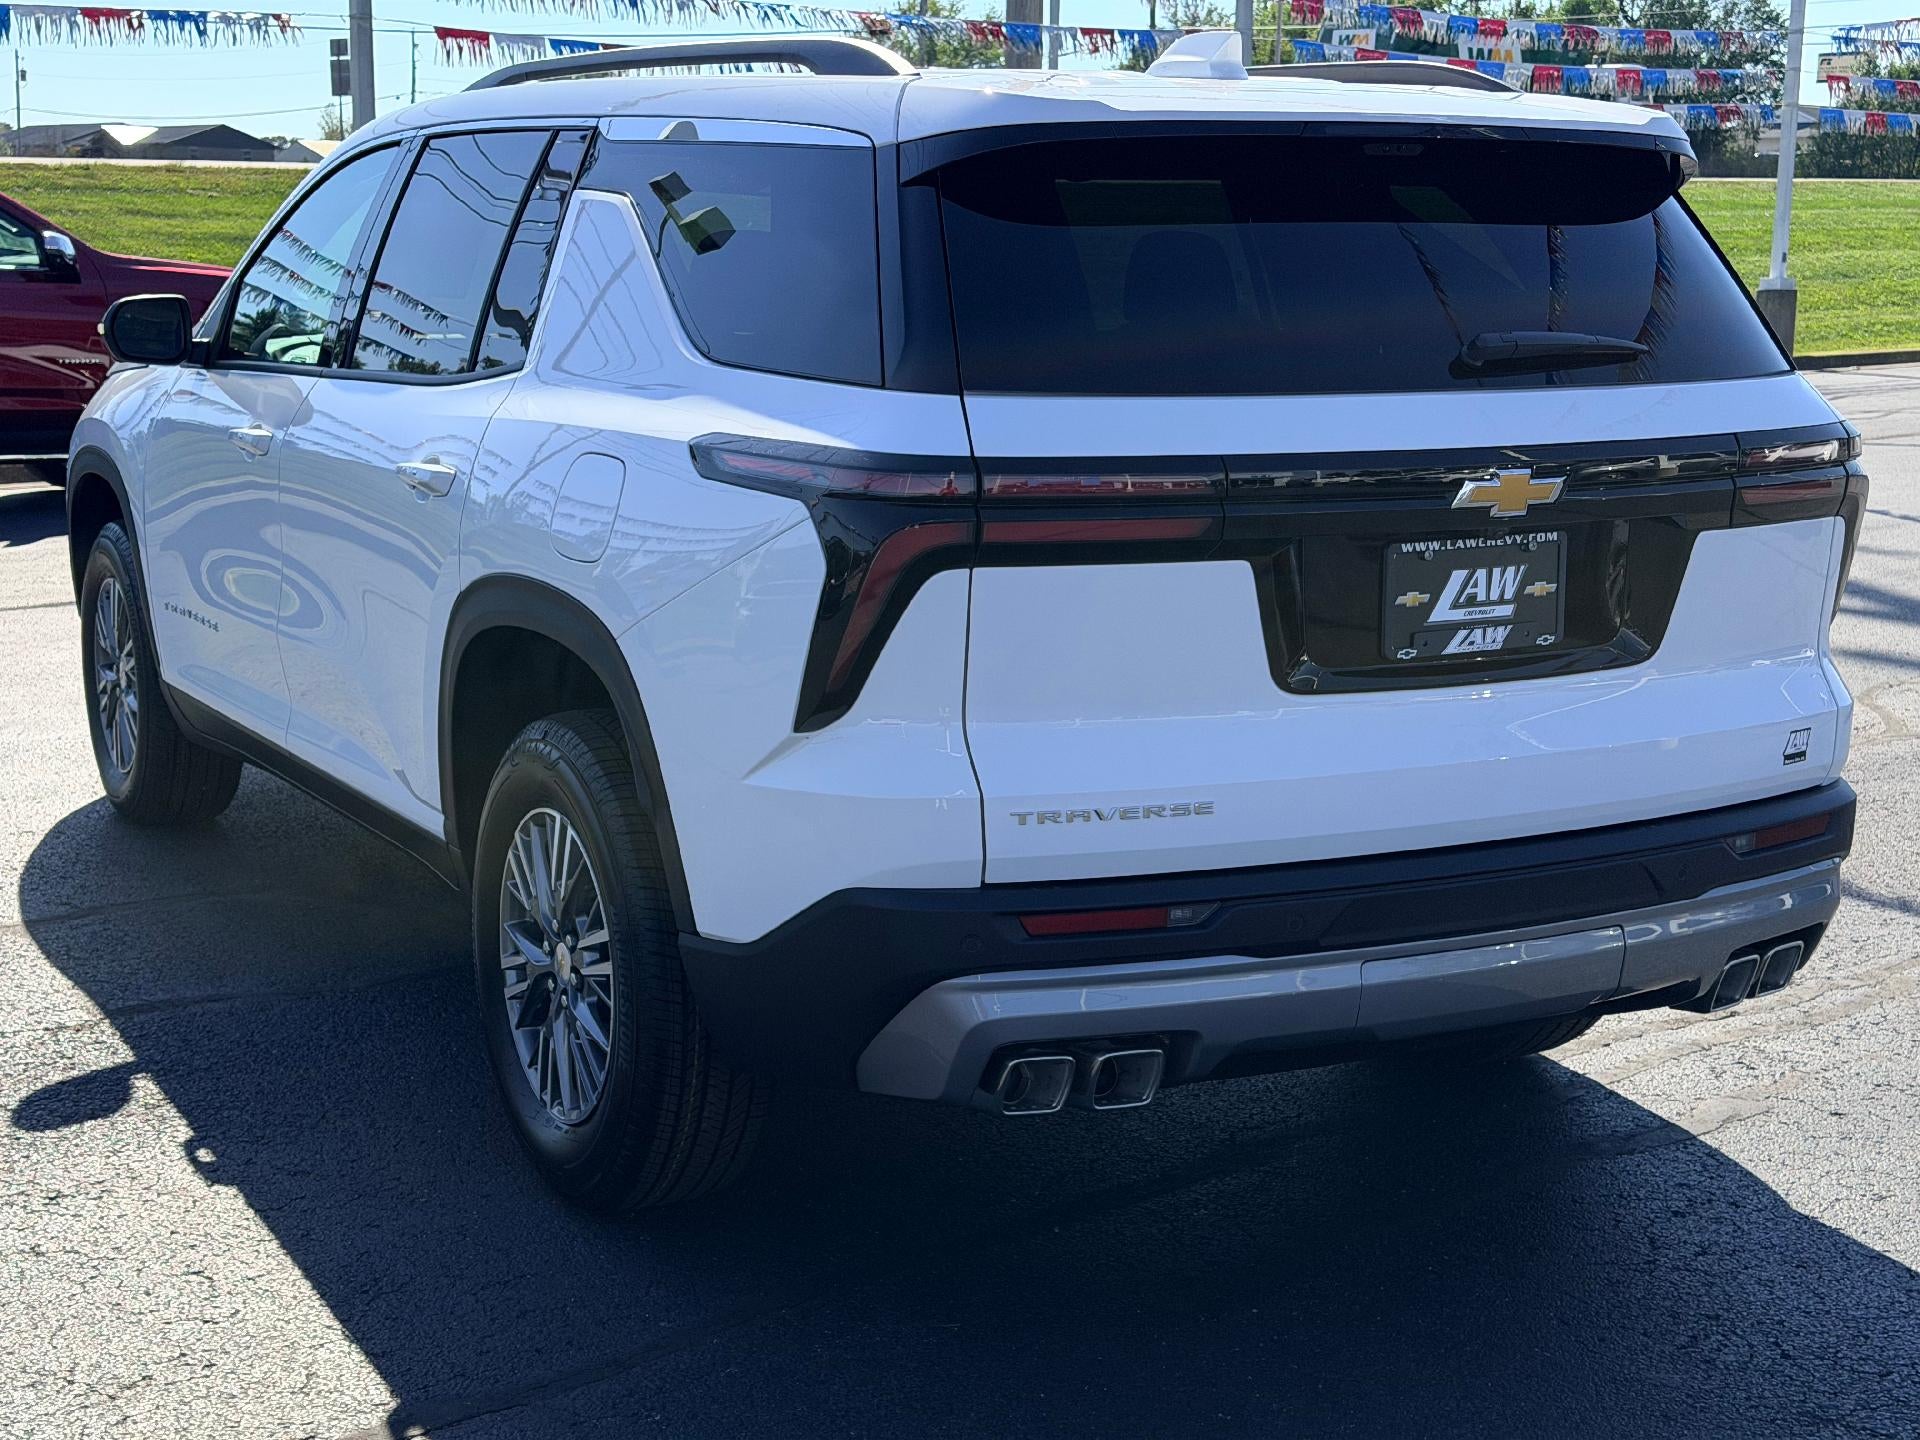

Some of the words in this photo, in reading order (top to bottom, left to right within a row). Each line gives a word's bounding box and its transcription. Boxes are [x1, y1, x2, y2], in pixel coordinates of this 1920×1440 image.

[1426, 563, 1528, 624] LAW
[1441, 624, 1514, 655] LAW
[1009, 800, 1215, 826] TRAVERSE
